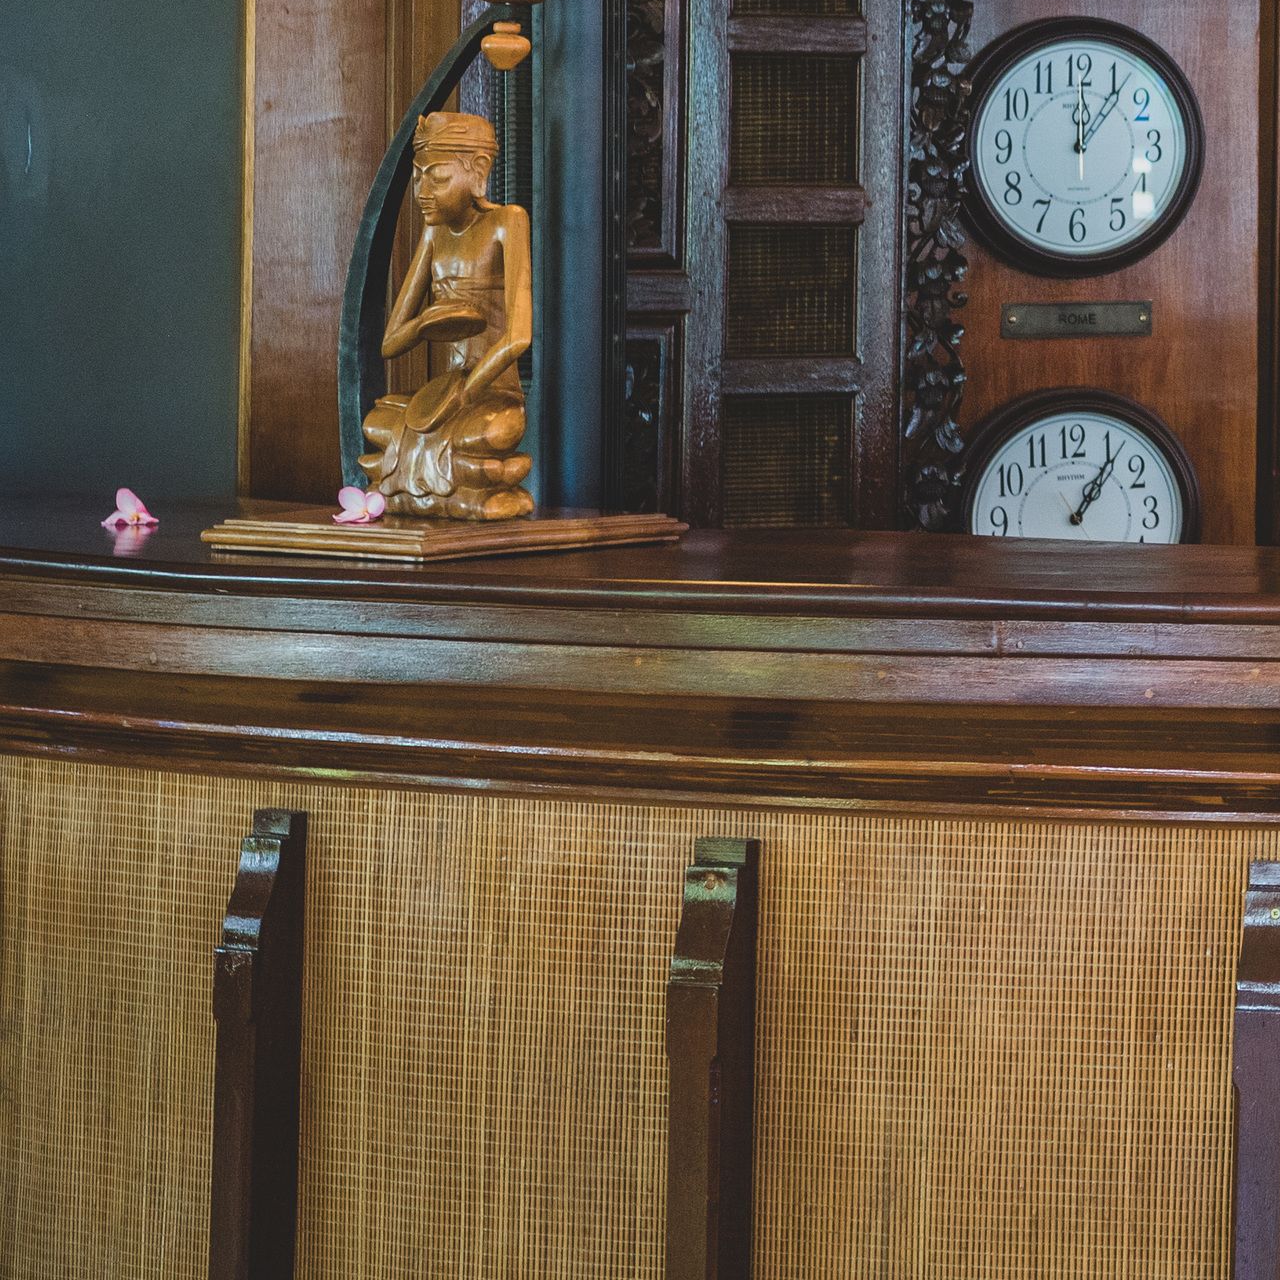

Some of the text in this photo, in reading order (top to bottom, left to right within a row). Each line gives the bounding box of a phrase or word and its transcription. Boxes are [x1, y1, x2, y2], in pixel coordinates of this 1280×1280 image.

[1033, 60, 1054, 95] 11
[1065, 53, 1092, 88] 12
[1108, 61, 1117, 94] 1
[1003, 87, 1029, 122] 10
[1133, 87, 1150, 122] 2
[994, 129, 1013, 164] 9
[1145, 128, 1162, 163] 3
[1003, 171, 1023, 206] 8
[1032, 199, 1052, 233] 7
[1068, 208, 1087, 242] 6
[1109, 197, 1126, 231] 5
[1058, 312, 1096, 325] ROME
[1026, 432, 1048, 468] 11
[1058, 423, 1086, 459] 12
[1102, 430, 1111, 463] 1
[996, 462, 1024, 497] 10
[1127, 455, 1146, 489] 2
[990, 505, 1008, 537] 9
[1142, 495, 1160, 529] 3
